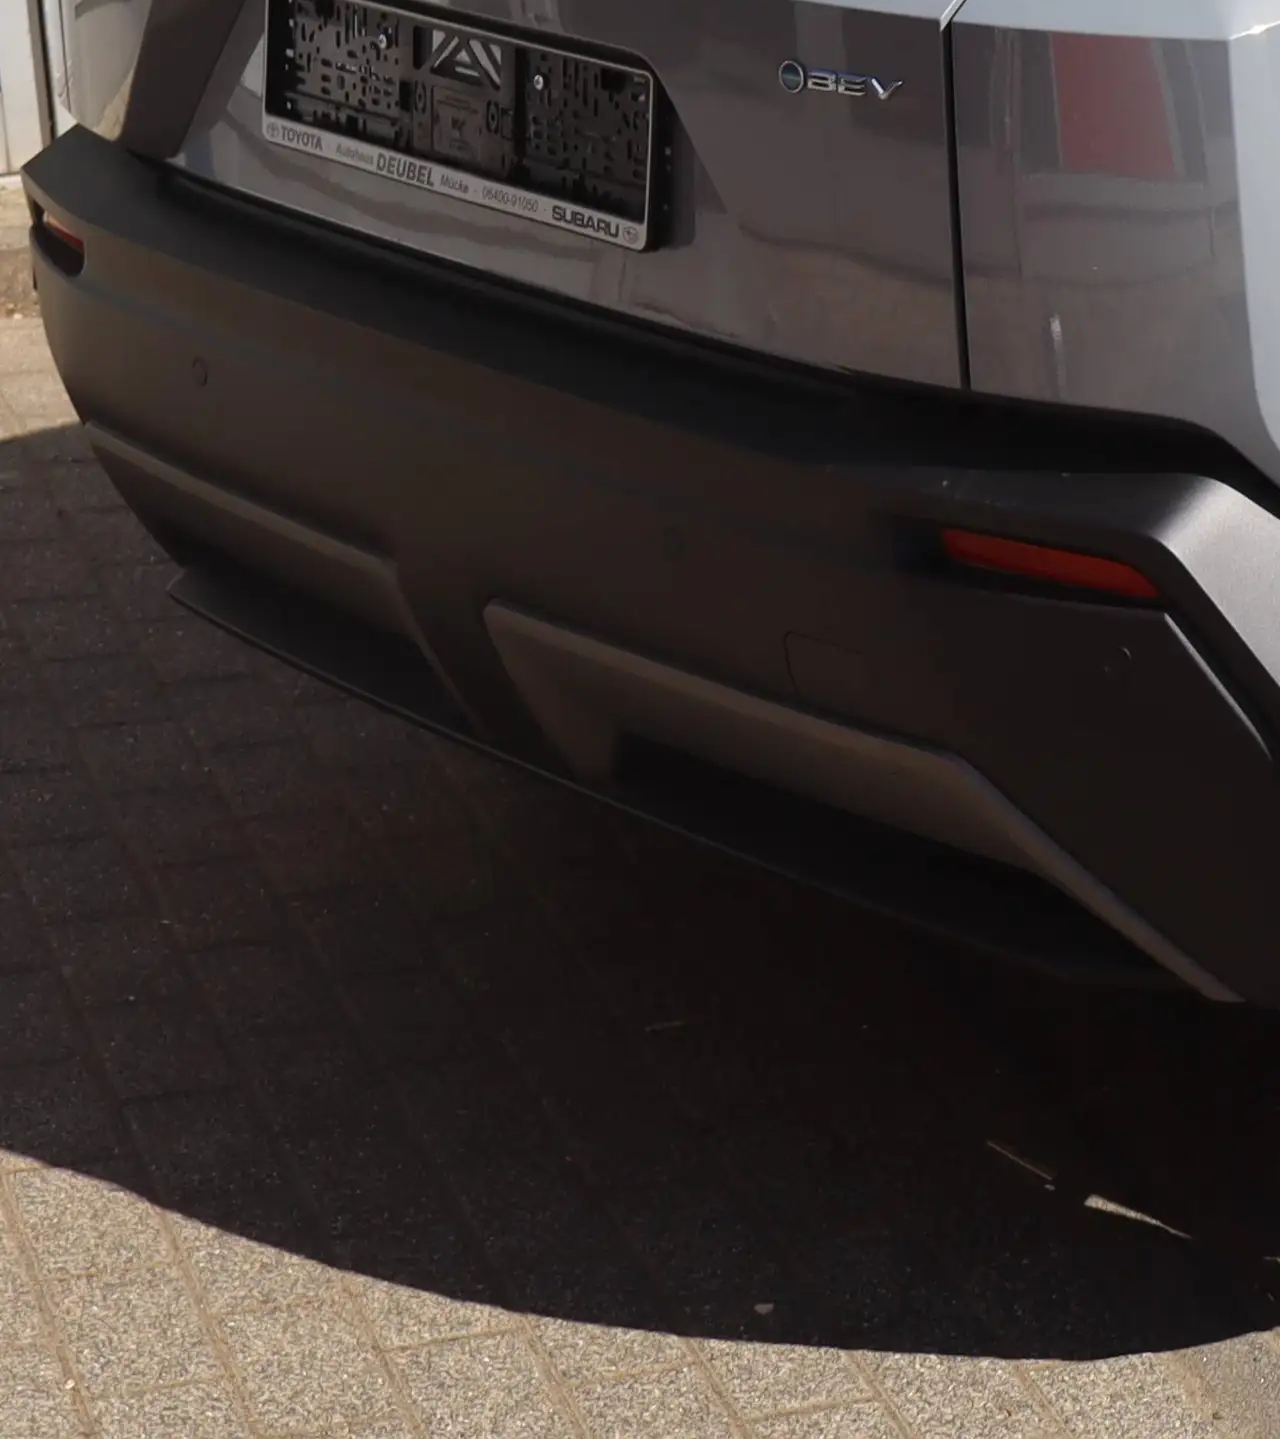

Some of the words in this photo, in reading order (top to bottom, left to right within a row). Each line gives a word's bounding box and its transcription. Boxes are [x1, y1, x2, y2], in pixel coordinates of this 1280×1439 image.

[281, 125, 323, 151] TOYOTA
[376, 152, 435, 187] DEUBEL
[551, 205, 620, 239] SUBARU
